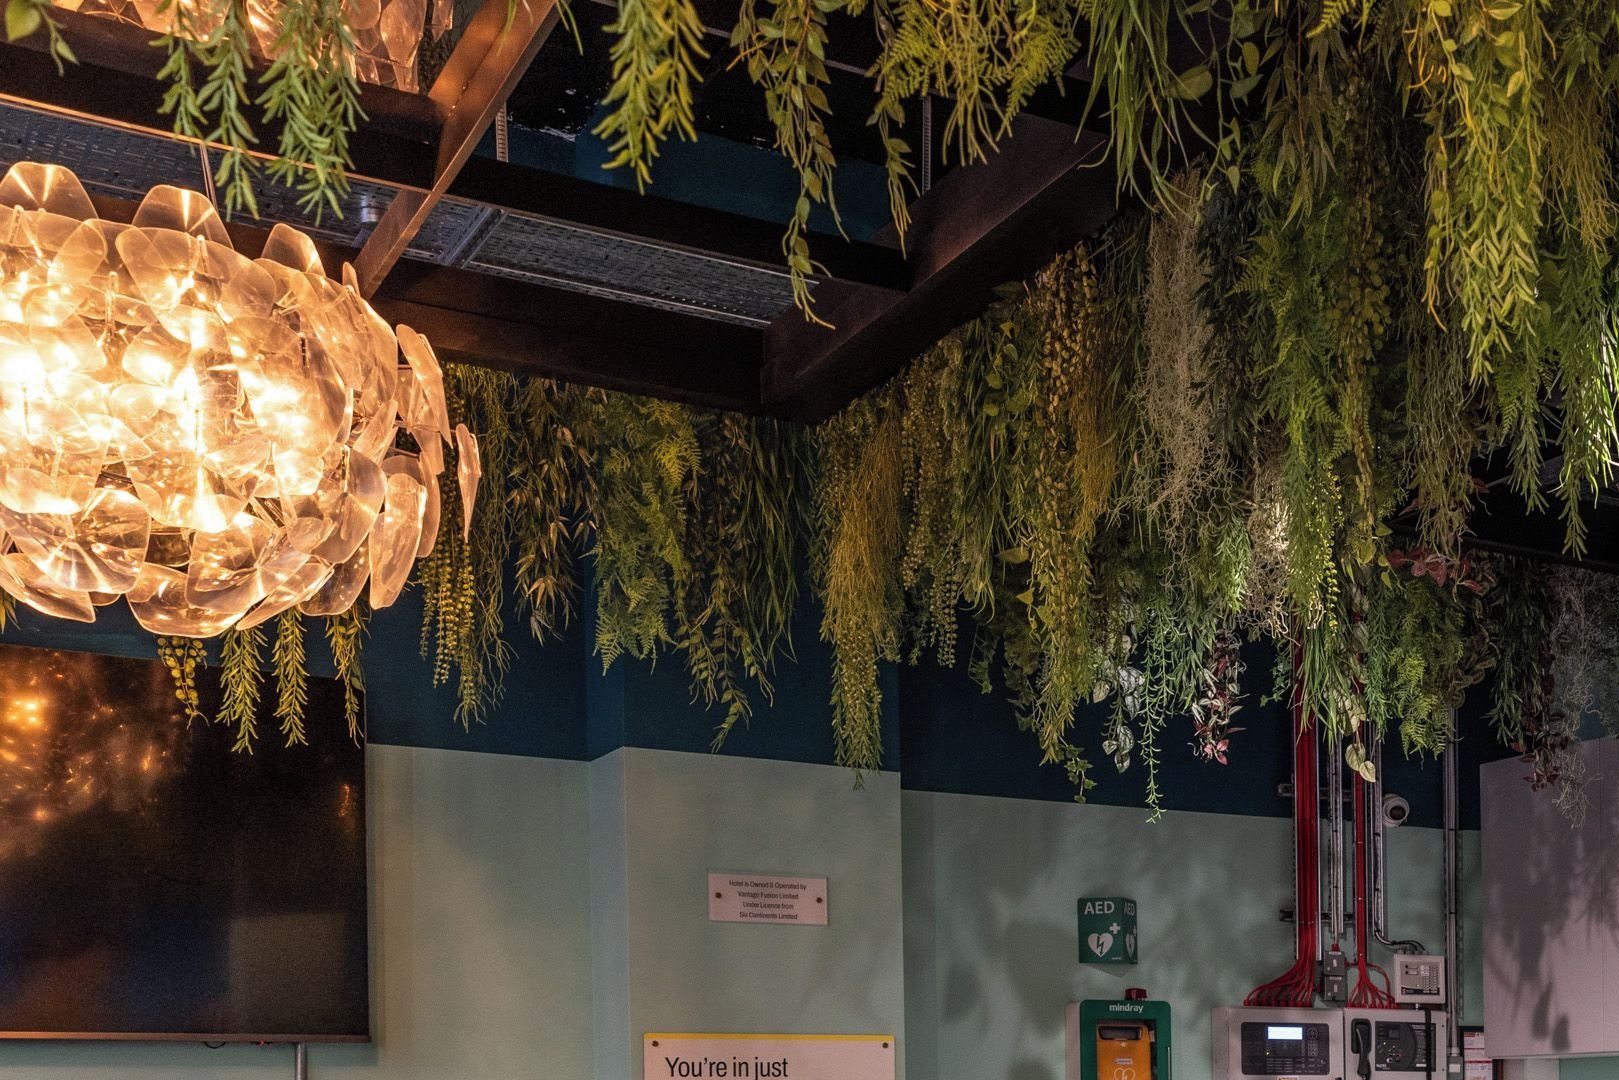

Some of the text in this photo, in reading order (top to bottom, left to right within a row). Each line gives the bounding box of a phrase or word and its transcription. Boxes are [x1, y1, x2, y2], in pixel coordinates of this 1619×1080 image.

[750, 881, 769, 889] Owned
[775, 882, 799, 890] Operated
[800, 883, 807, 891] by
[738, 891, 799, 900] Vantage Fusion Limited
[781, 902, 794, 910] from
[1084, 901, 1136, 916] AED AED
[749, 911, 778, 919] Continents
[778, 912, 798, 920] Limited
[1109, 1003, 1144, 1014] mindray
[733, 1056, 749, 1078] in
